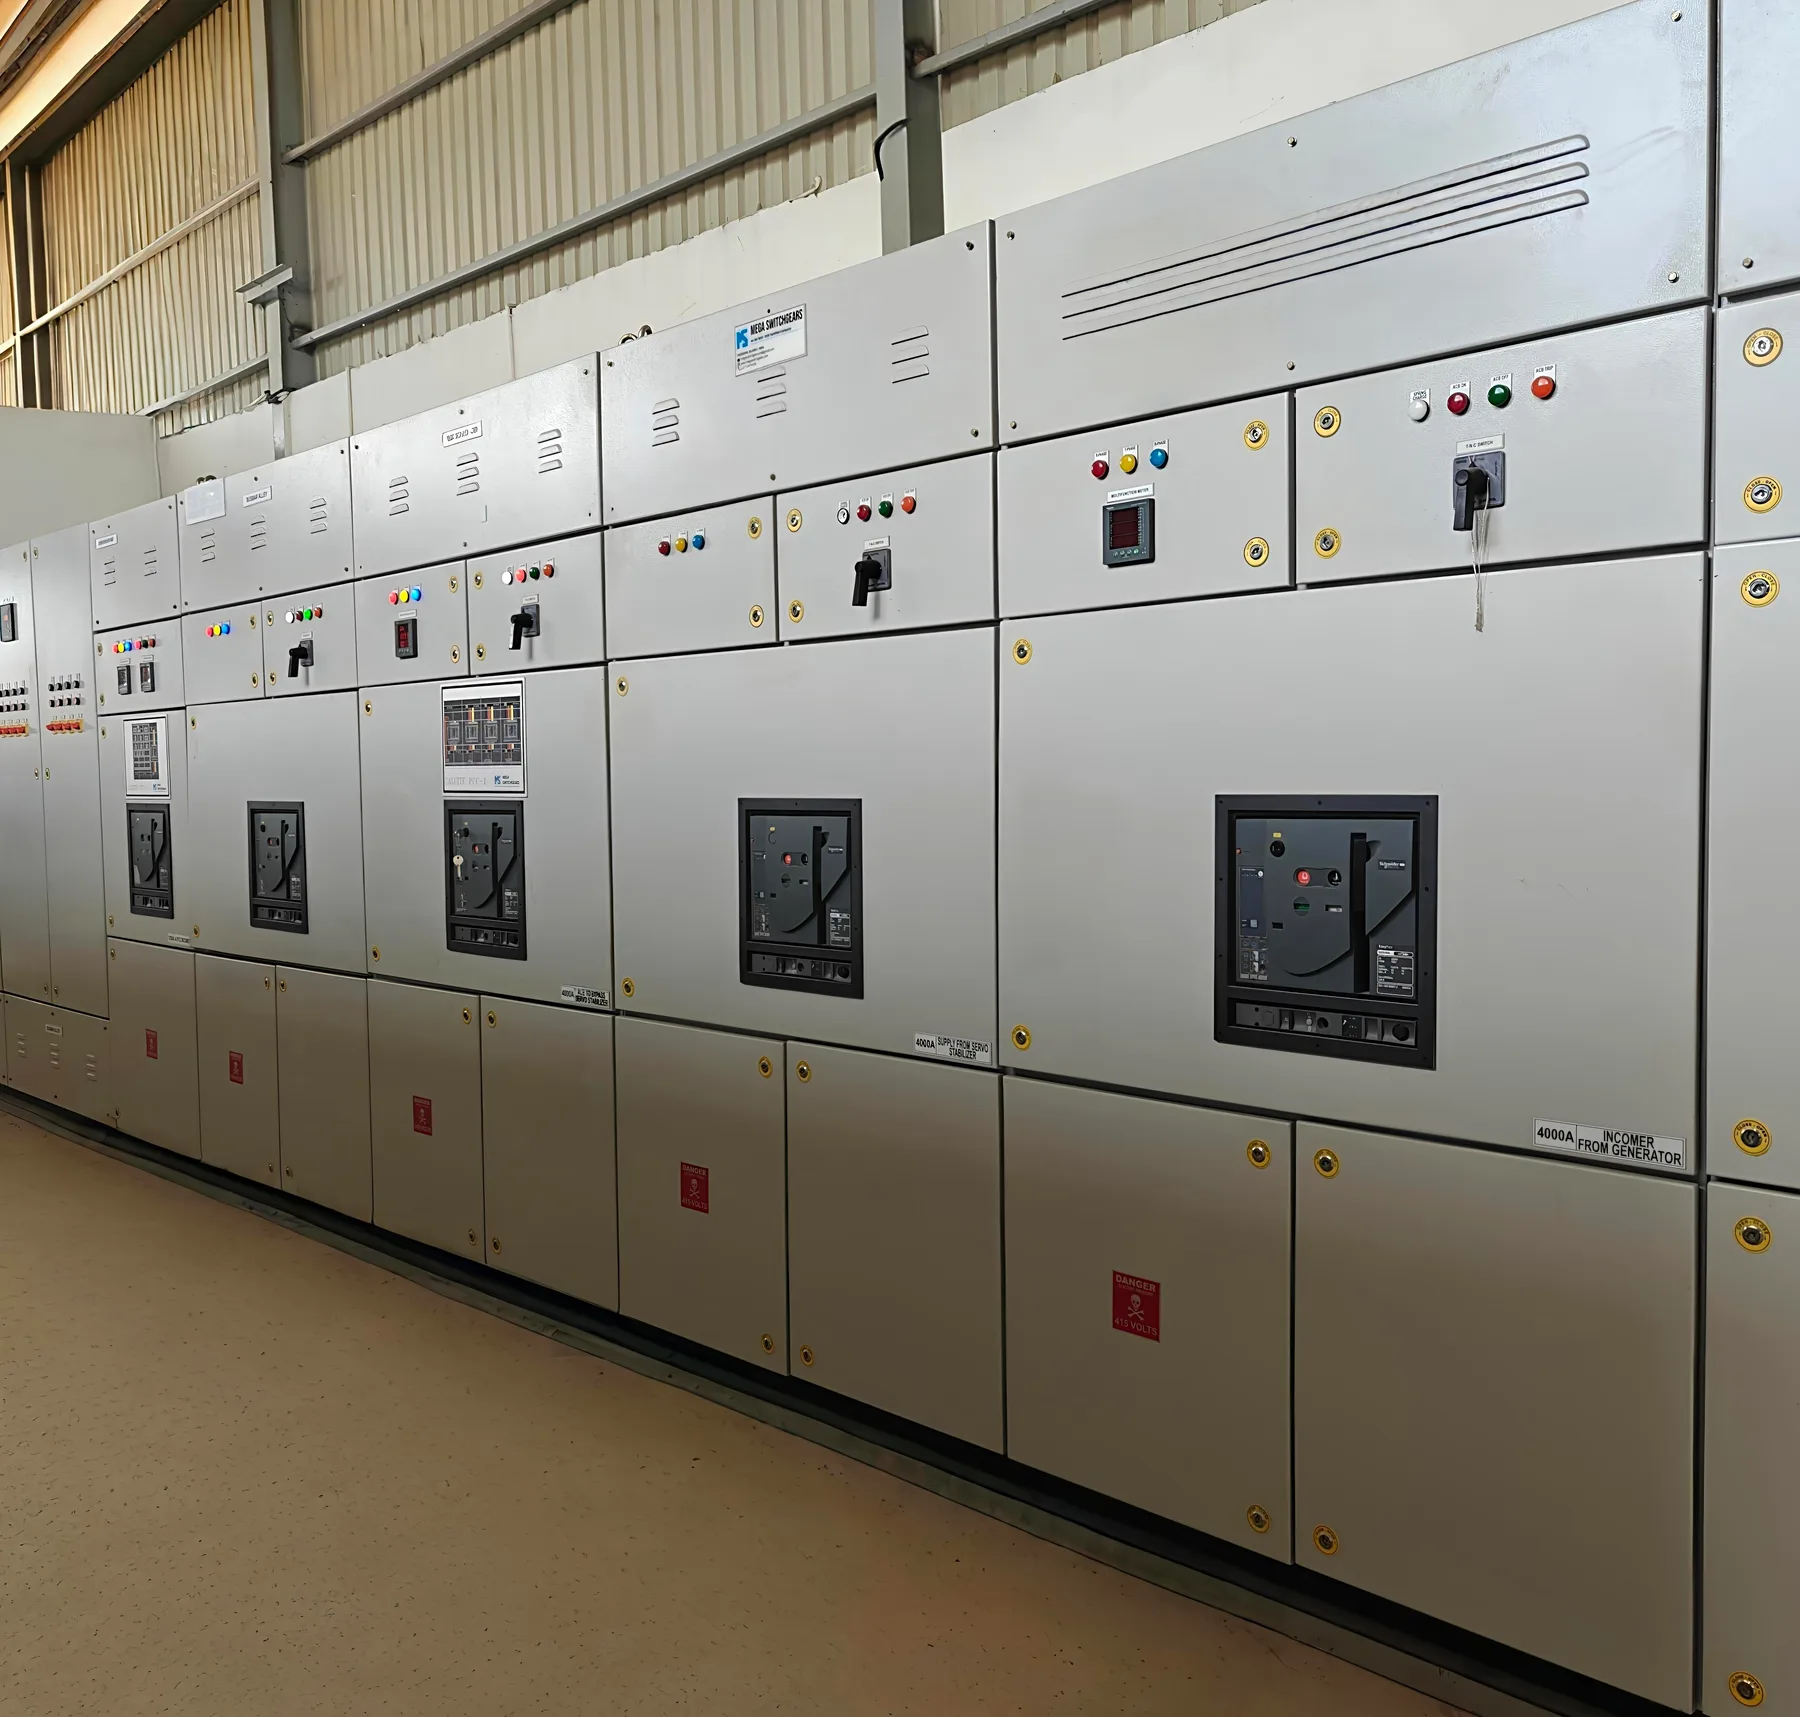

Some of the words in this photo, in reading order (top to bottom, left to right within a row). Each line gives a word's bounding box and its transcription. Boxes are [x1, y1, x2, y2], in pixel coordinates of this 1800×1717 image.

[750, 322, 765, 336] MEGA
[766, 308, 803, 330] SWITCHGEARS
[916, 1038, 936, 1048] 4000A
[938, 1036, 956, 1048] SUPPLY
[956, 1040, 970, 1050] FROM
[972, 1042, 988, 1052] SERVO
[948, 1048, 976, 1060] STABILIZER
[1537, 1126, 1574, 1143] 4000A
[1604, 1130, 1654, 1148] INCOMER
[1578, 1138, 1608, 1154] FROM
[1612, 1144, 1682, 1166] GENERATOR
[682, 1164, 706, 1176] DANGER
[1116, 1274, 1156, 1292] DANGER
[1114, 1317, 1128, 1327] 415
[1130, 1321, 1158, 1336] VOLTS
